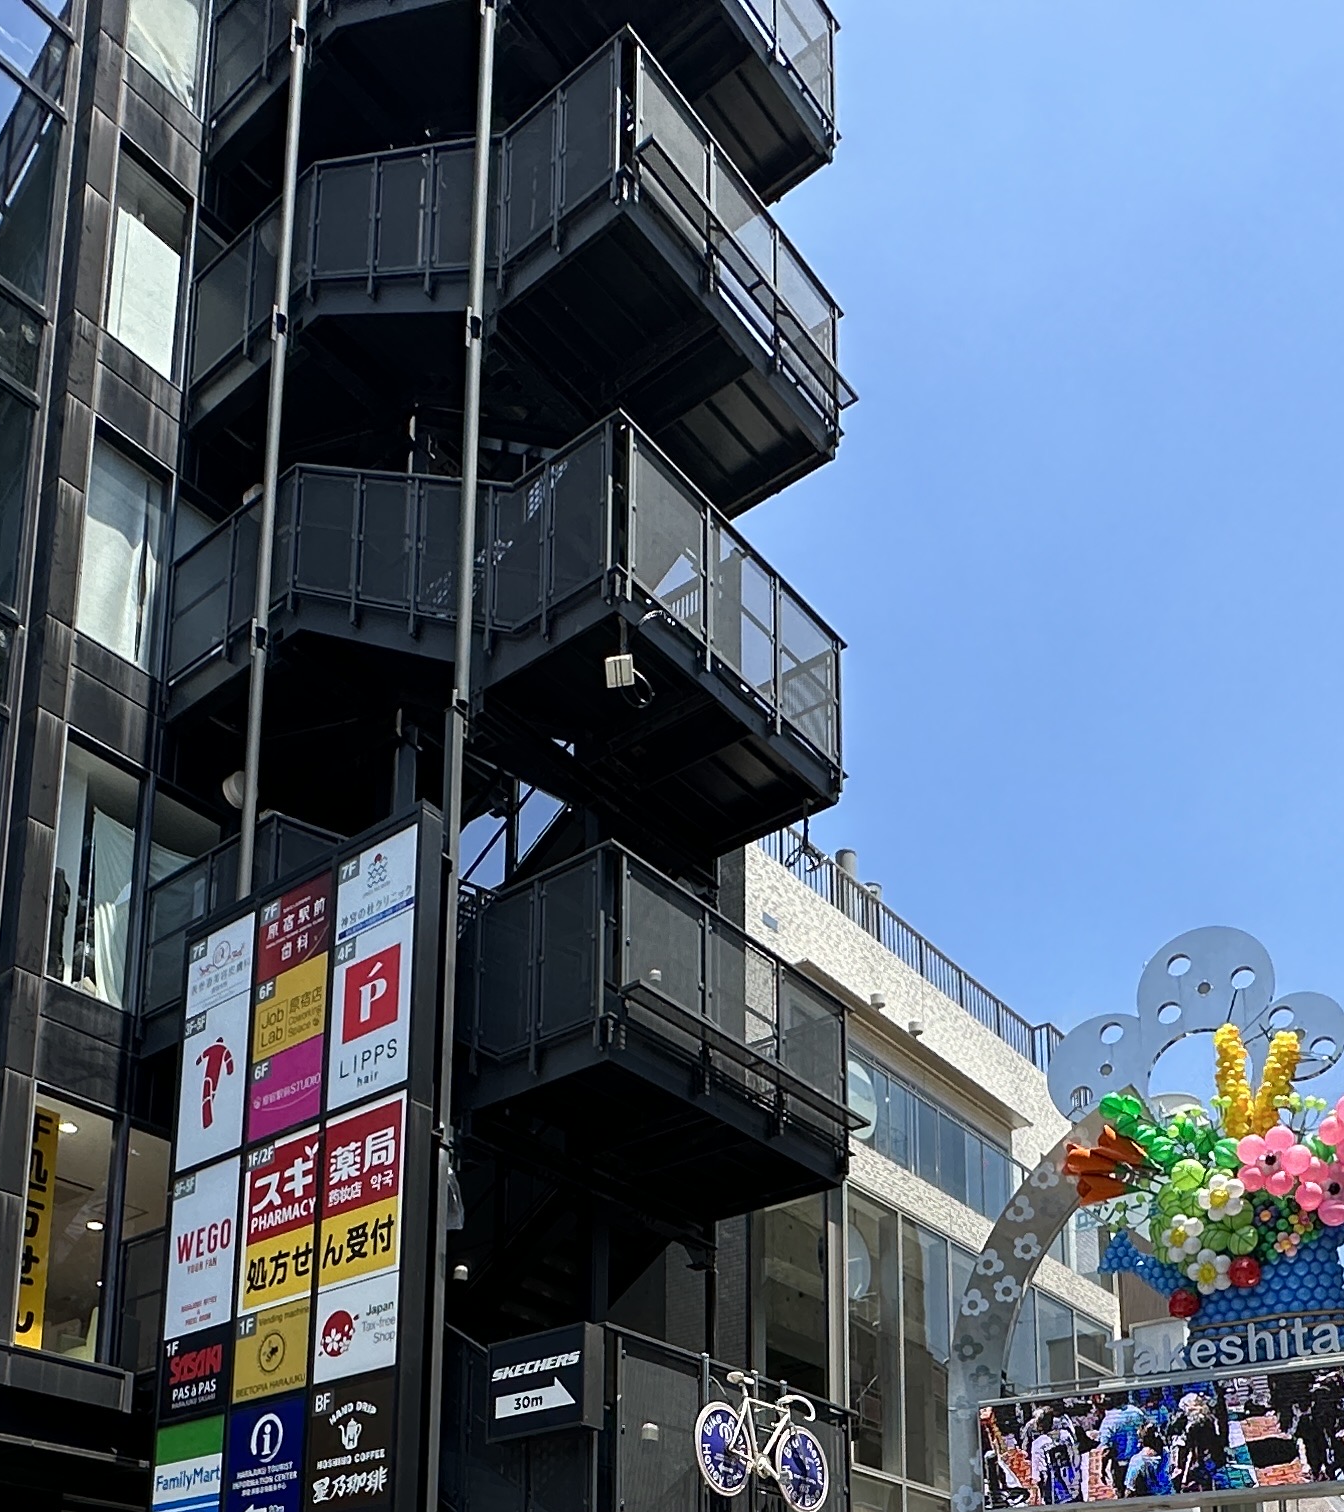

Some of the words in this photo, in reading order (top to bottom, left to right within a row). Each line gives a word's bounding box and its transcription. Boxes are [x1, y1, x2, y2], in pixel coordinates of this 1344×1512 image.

[342, 860, 357, 879] 7F
[264, 902, 278, 920] 7F
[266, 897, 326, 941] 原宿駅前
[193, 942, 206, 959] 7F
[281, 932, 308, 961] 歯科
[337, 943, 354, 961] 4F
[259, 981, 274, 1000] 6F
[262, 1007, 284, 1029] Job
[261, 1027, 284, 1048] Lab
[339, 1038, 398, 1079] LIPPS
[254, 1062, 269, 1080] 6F
[357, 1069, 380, 1087] hair
[247, 1145, 274, 1168] 1F/2F
[251, 1197, 316, 1233] PHARMACY
[177, 1218, 232, 1264] WEGO
[365, 1301, 394, 1317] Japan
[239, 1317, 254, 1335] 1F
[361, 1315, 396, 1332] Tax-free
[373, 1330, 395, 1345] Shop
[166, 1341, 180, 1358] 1F
[1105, 1318, 1341, 1377] Takeshita
[492, 1351, 580, 1382] SKECHERS
[315, 1392, 331, 1413] BF
[514, 1394, 543, 1410] 30m
[354, 1448, 386, 1463] COFFEE
[156, 1465, 221, 1492] FamilyMart
